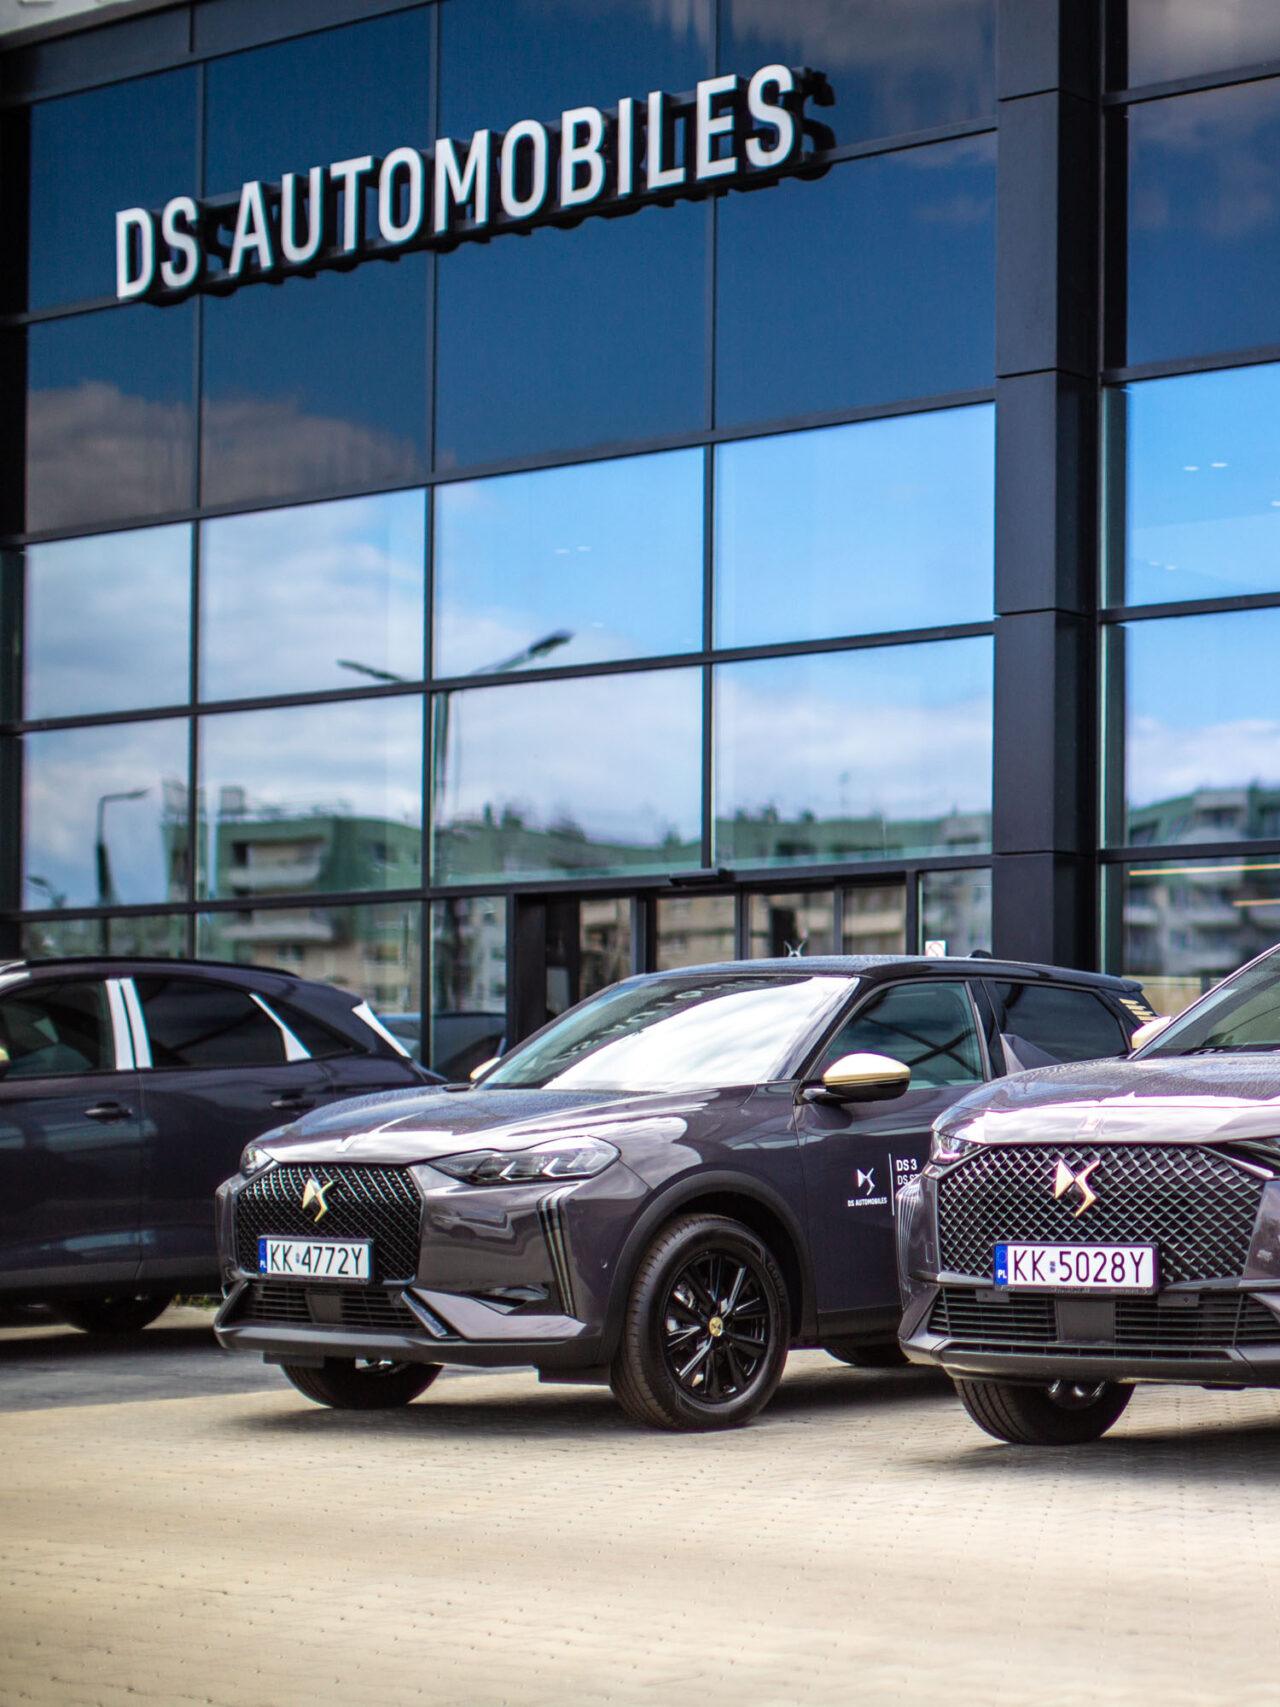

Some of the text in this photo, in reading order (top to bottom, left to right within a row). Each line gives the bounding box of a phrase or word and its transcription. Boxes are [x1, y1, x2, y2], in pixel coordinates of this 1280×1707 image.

[115, 63, 796, 300] DS AUTOMOBILES
[896, 1158, 917, 1172] DS 3
[897, 1174, 908, 1185] DS
[270, 1244, 363, 1275] KK 4772Y
[1013, 1250, 1145, 1283] KK 5028Y
[997, 1269, 1007, 1279] PL
